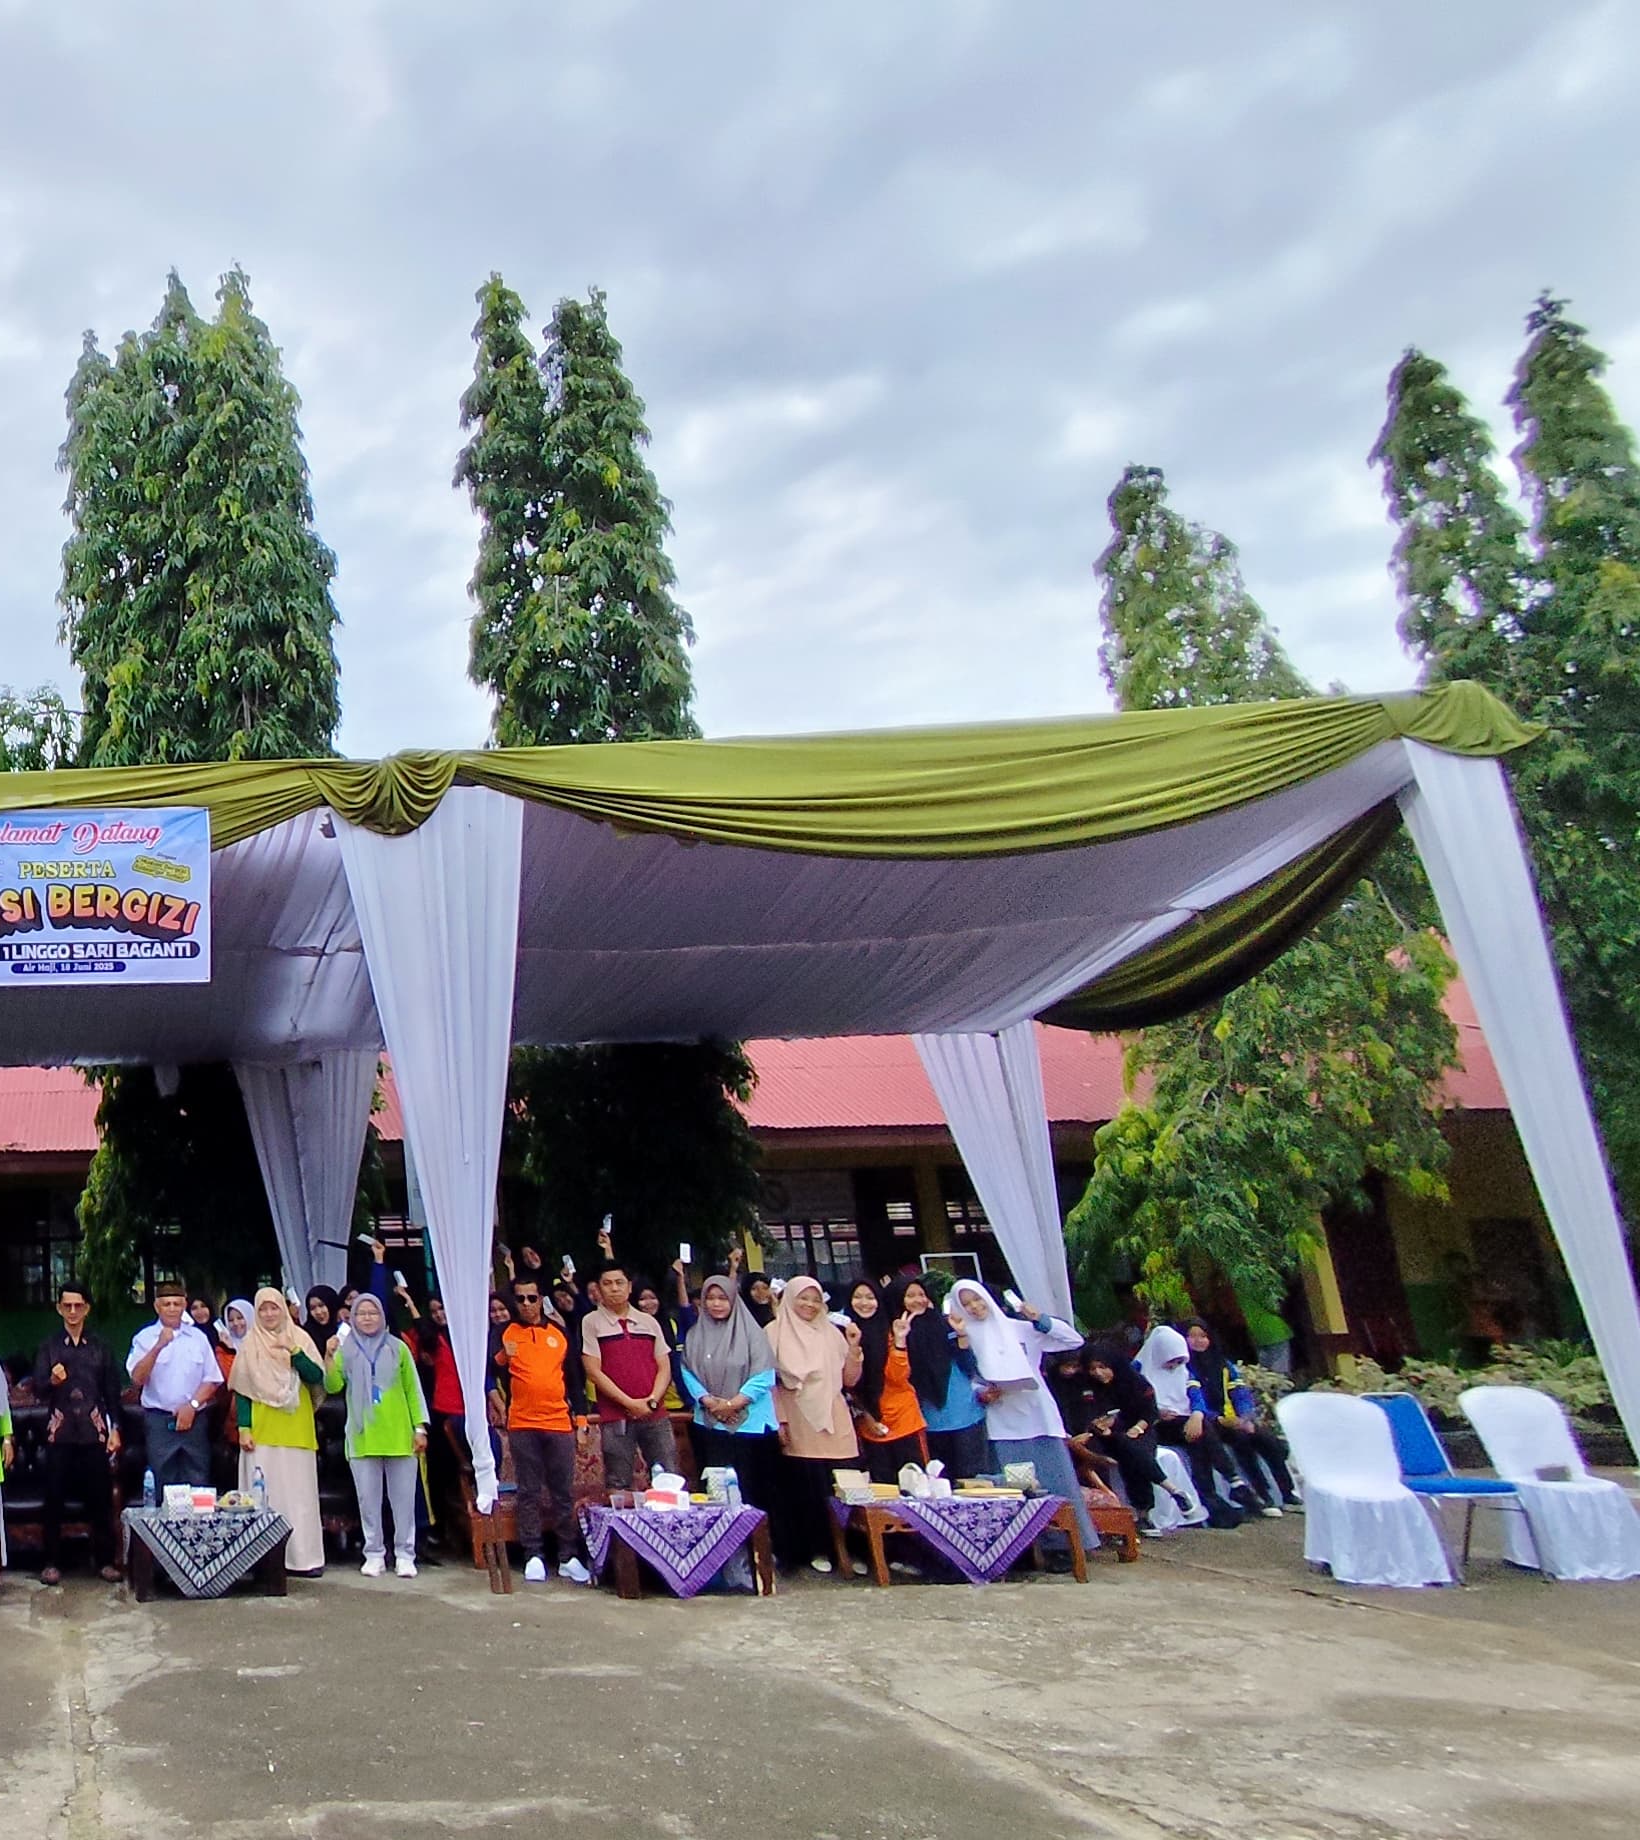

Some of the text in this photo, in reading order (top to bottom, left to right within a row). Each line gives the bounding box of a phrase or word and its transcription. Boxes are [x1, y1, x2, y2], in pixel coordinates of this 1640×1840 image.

[72, 822, 161, 854] Datang
[18, 861, 117, 879] PESERTA
[47, 884, 200, 935] BERGIZI
[2, 947, 10, 959] 1
[11, 943, 70, 960] LINGGO
[72, 943, 114, 958] SARI
[116, 941, 191, 958] BAGANTI
[23, 963, 36, 972] Air
[38, 962, 58, 973] Haji,
[73, 962, 92, 971] Juni
